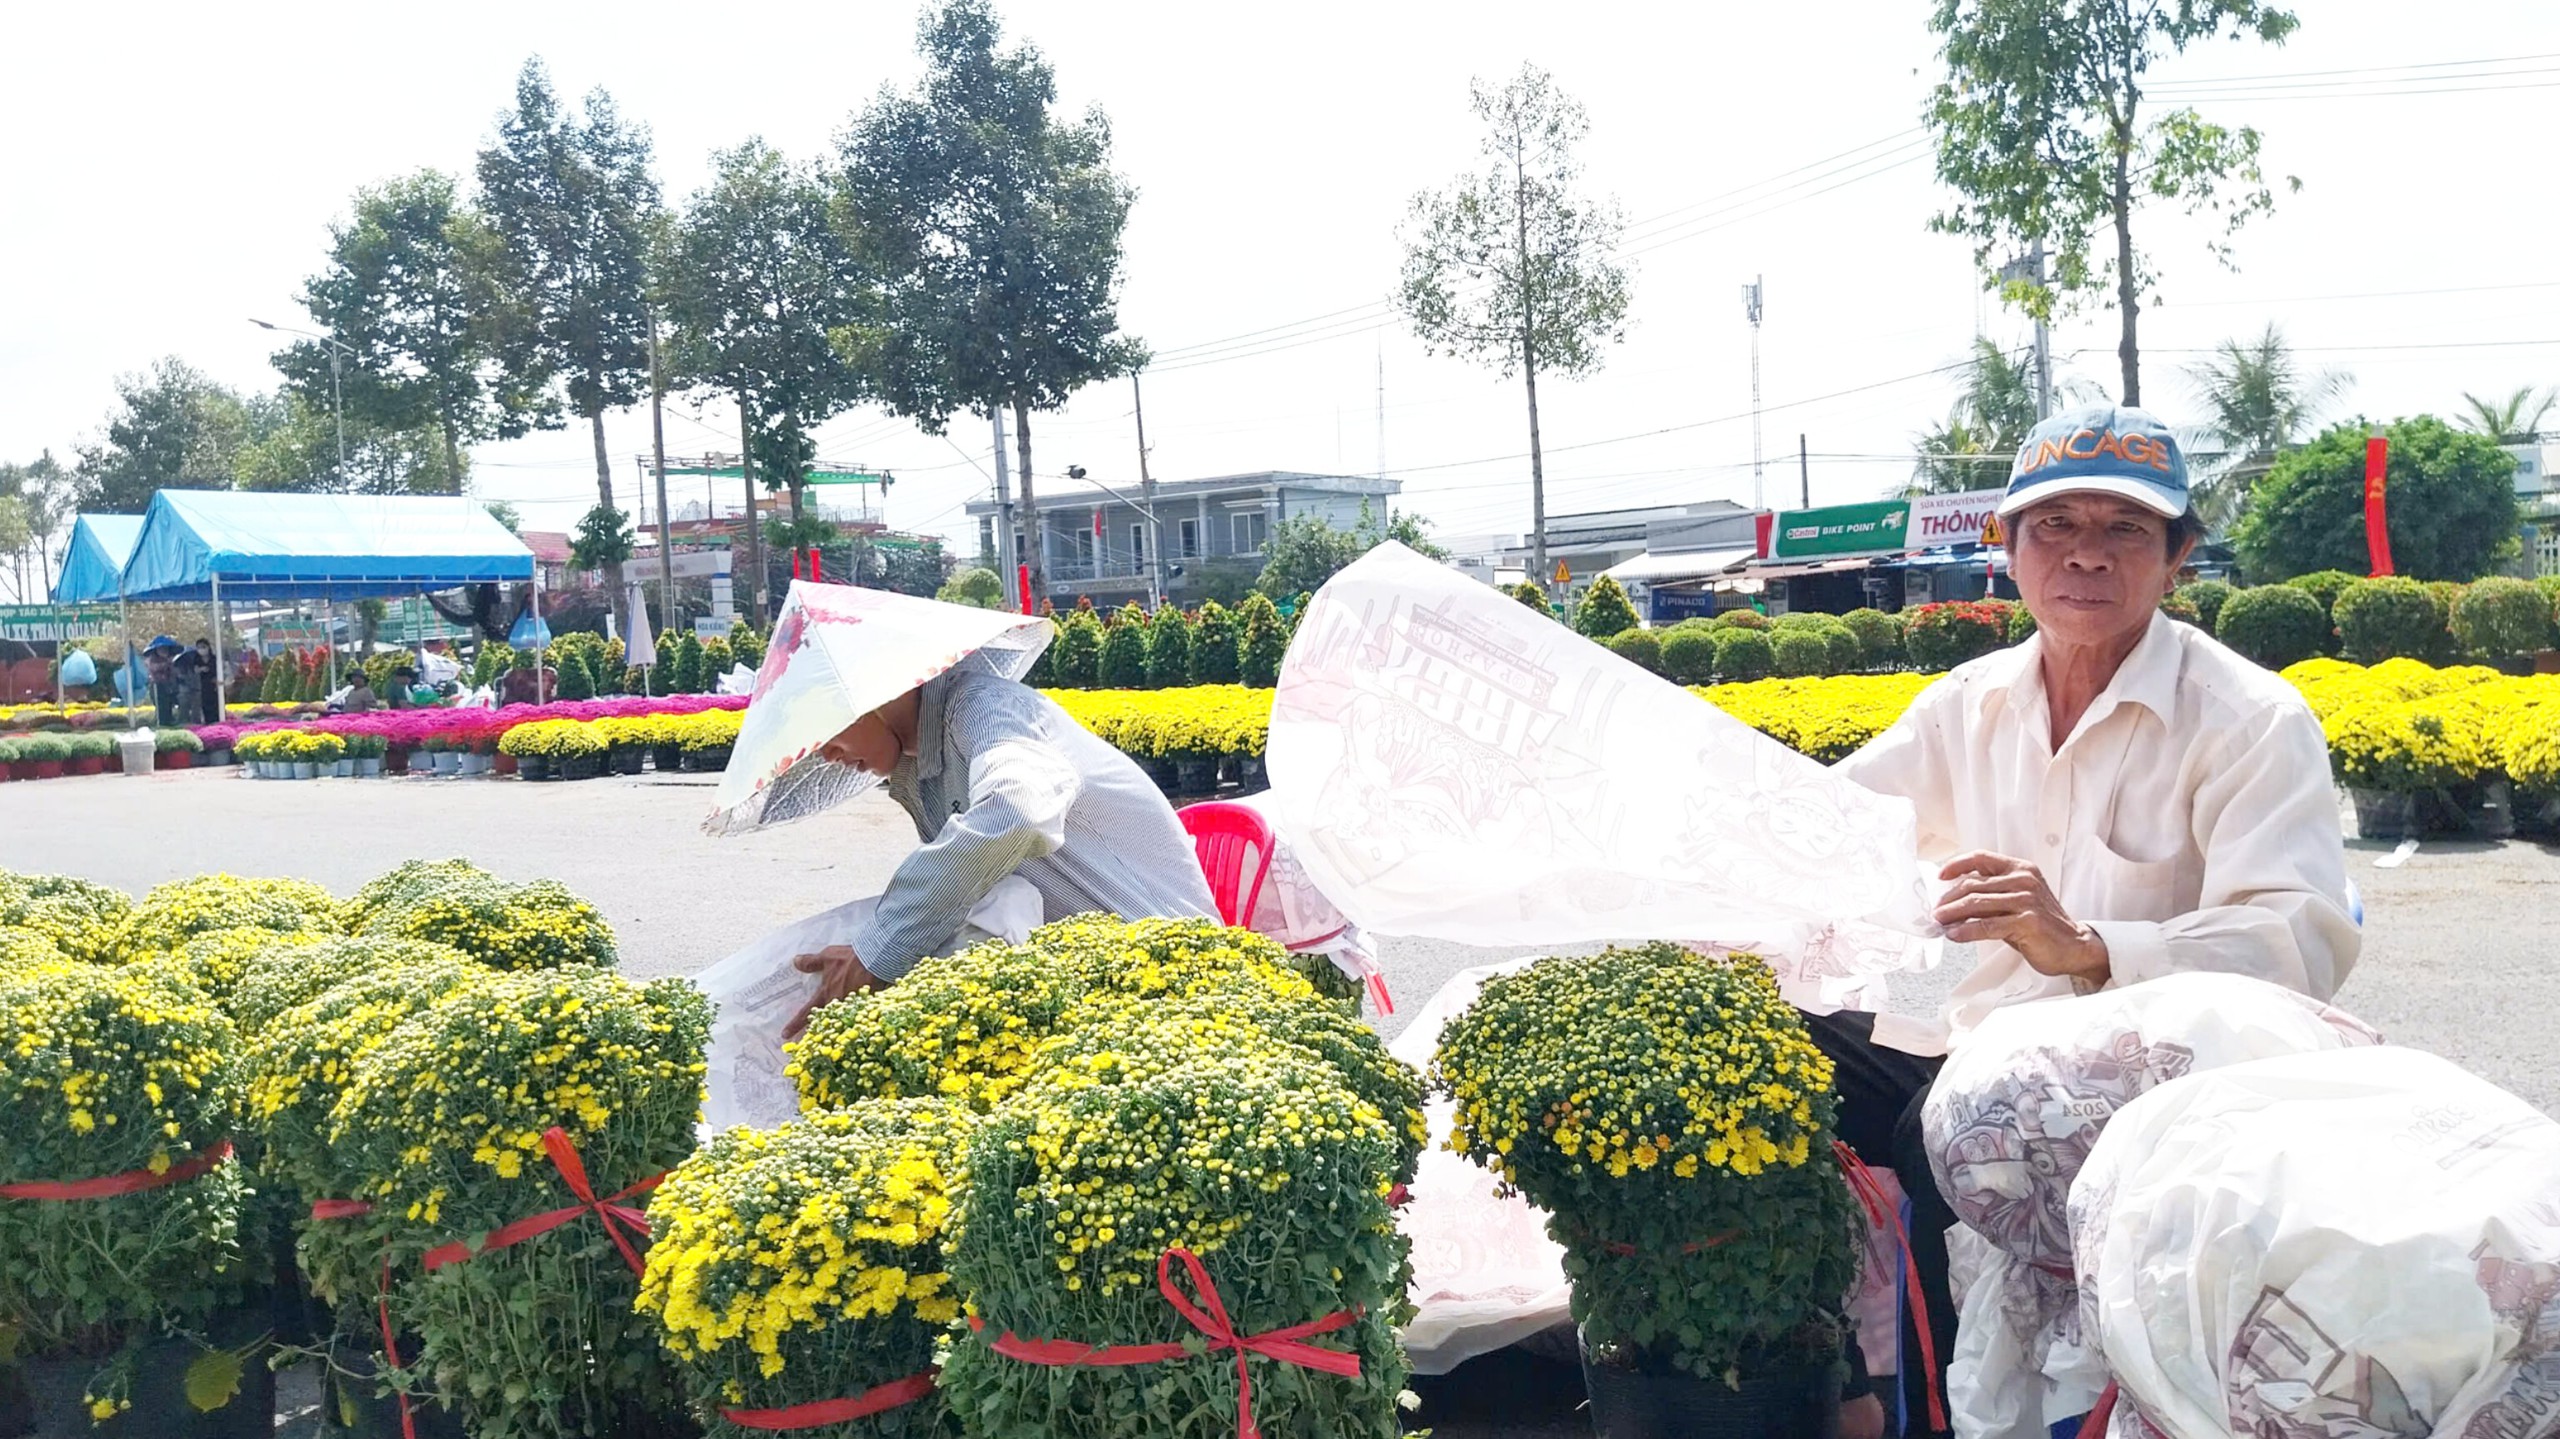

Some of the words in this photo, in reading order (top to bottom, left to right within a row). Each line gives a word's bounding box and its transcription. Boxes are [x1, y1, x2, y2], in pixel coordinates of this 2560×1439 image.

[2023, 429, 2170, 474] UNCAGE
[1936, 499, 1945, 508] XE
[1822, 525, 1844, 535] BIKE
[1847, 522, 1876, 534] POINT
[1667, 596, 1706, 606] PINACO
